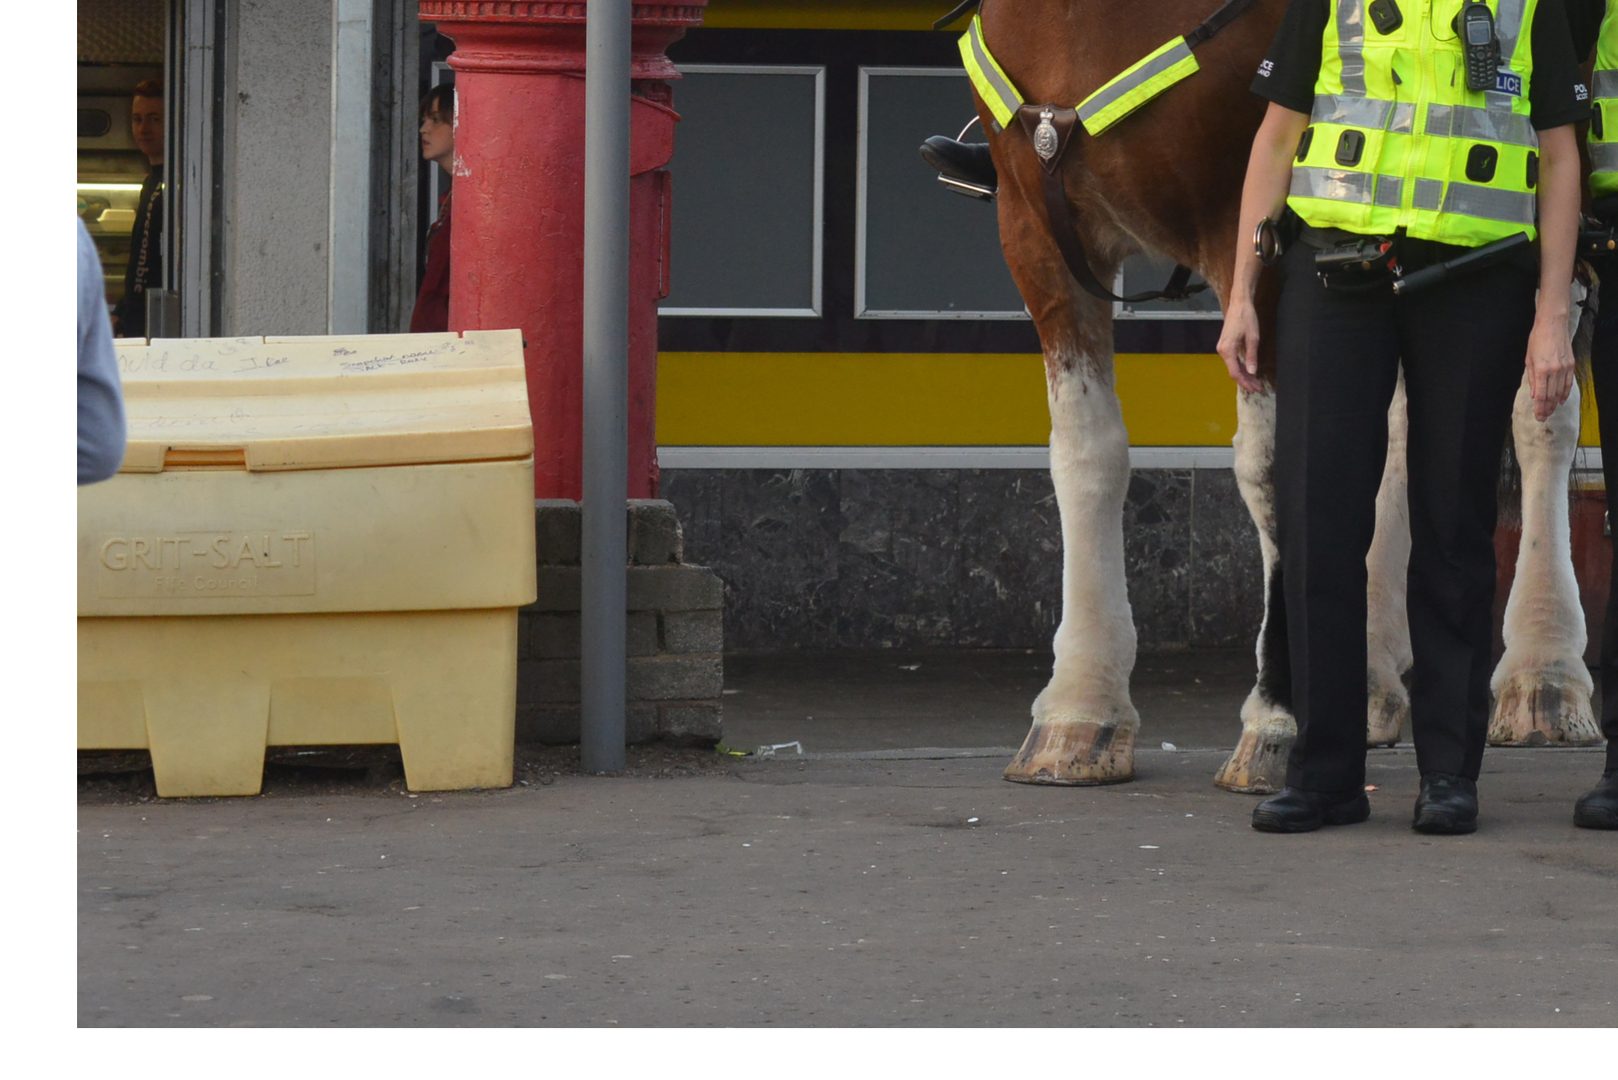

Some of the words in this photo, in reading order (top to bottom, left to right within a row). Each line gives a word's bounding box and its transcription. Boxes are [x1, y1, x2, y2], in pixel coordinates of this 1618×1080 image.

[1496, 77, 1519, 93] LICE
[1574, 84, 1587, 93] POL
[101, 534, 309, 571] GRIT-SALT
[155, 576, 186, 591] Fife
[194, 575, 258, 590] Council
